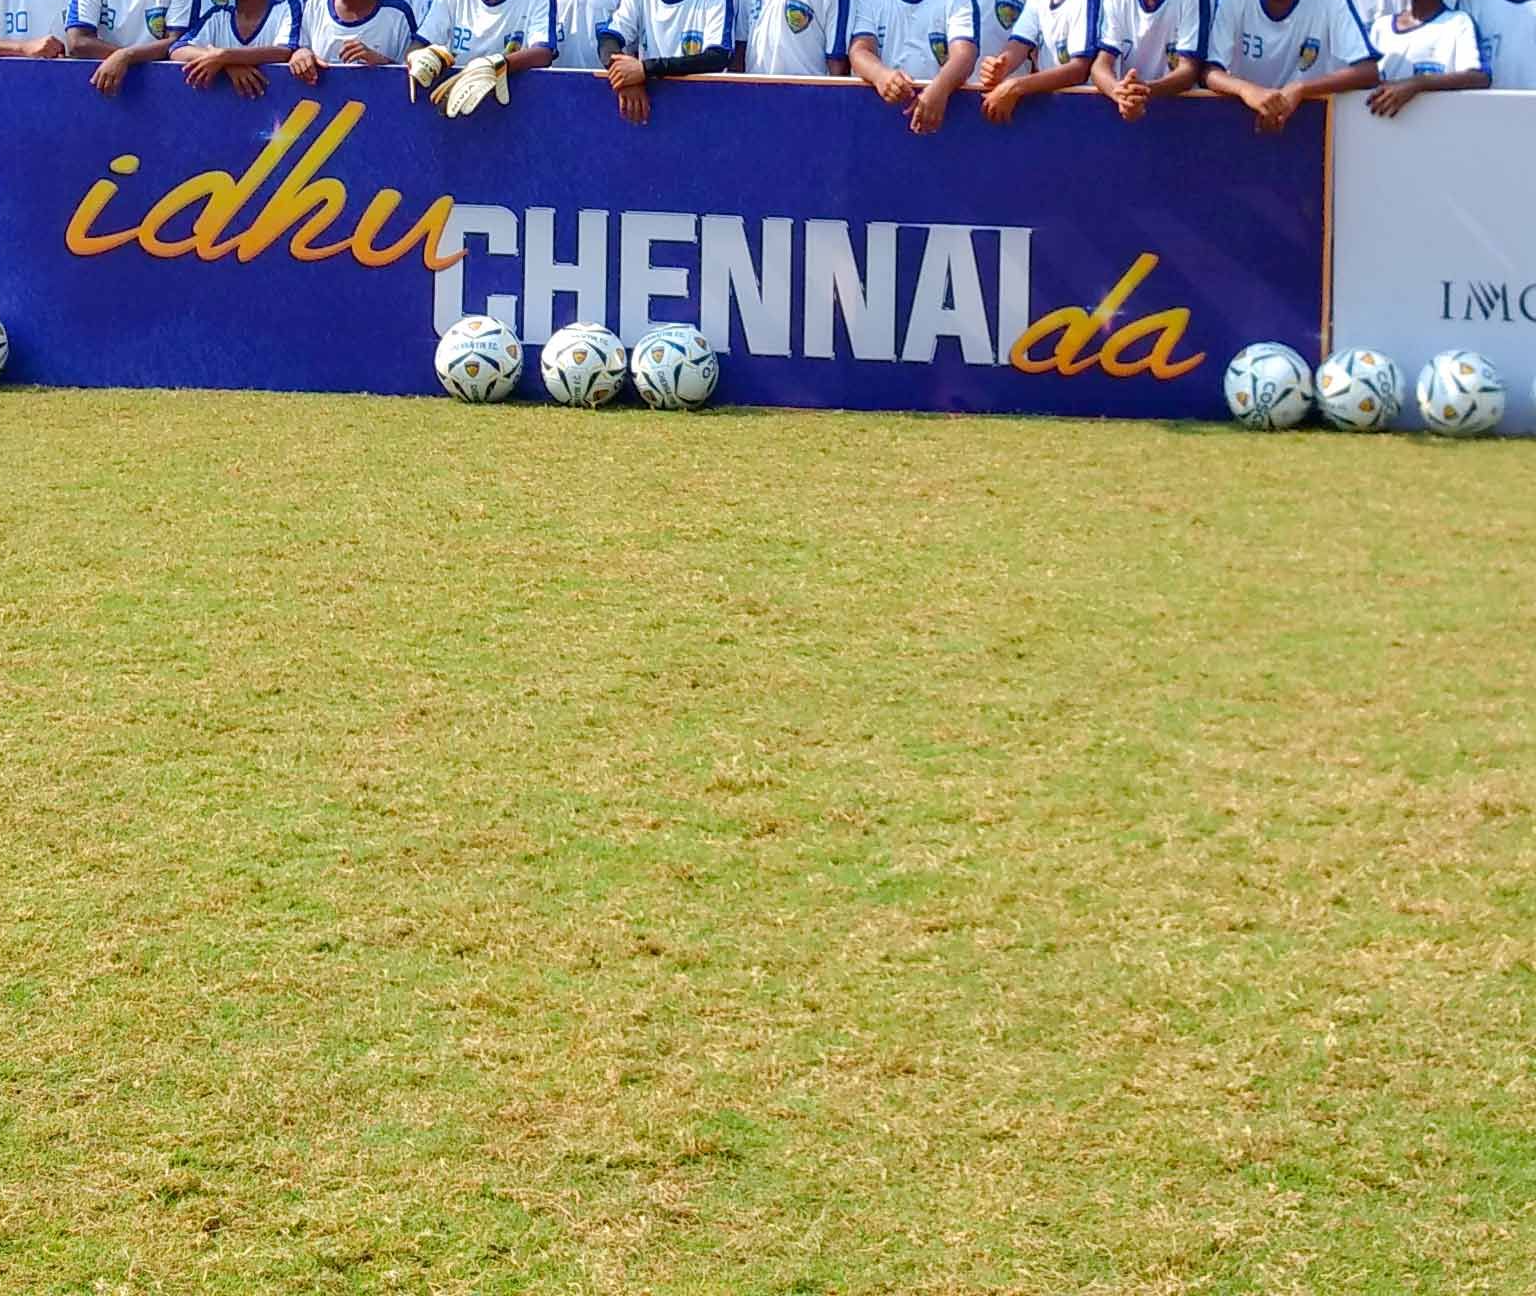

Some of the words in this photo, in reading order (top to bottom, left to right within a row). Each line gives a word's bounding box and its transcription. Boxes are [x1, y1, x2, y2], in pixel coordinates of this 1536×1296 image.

[65, 99, 469, 271] idhu
[433, 203, 1034, 367] CHENNAI
[1009, 250, 1206, 380] da
